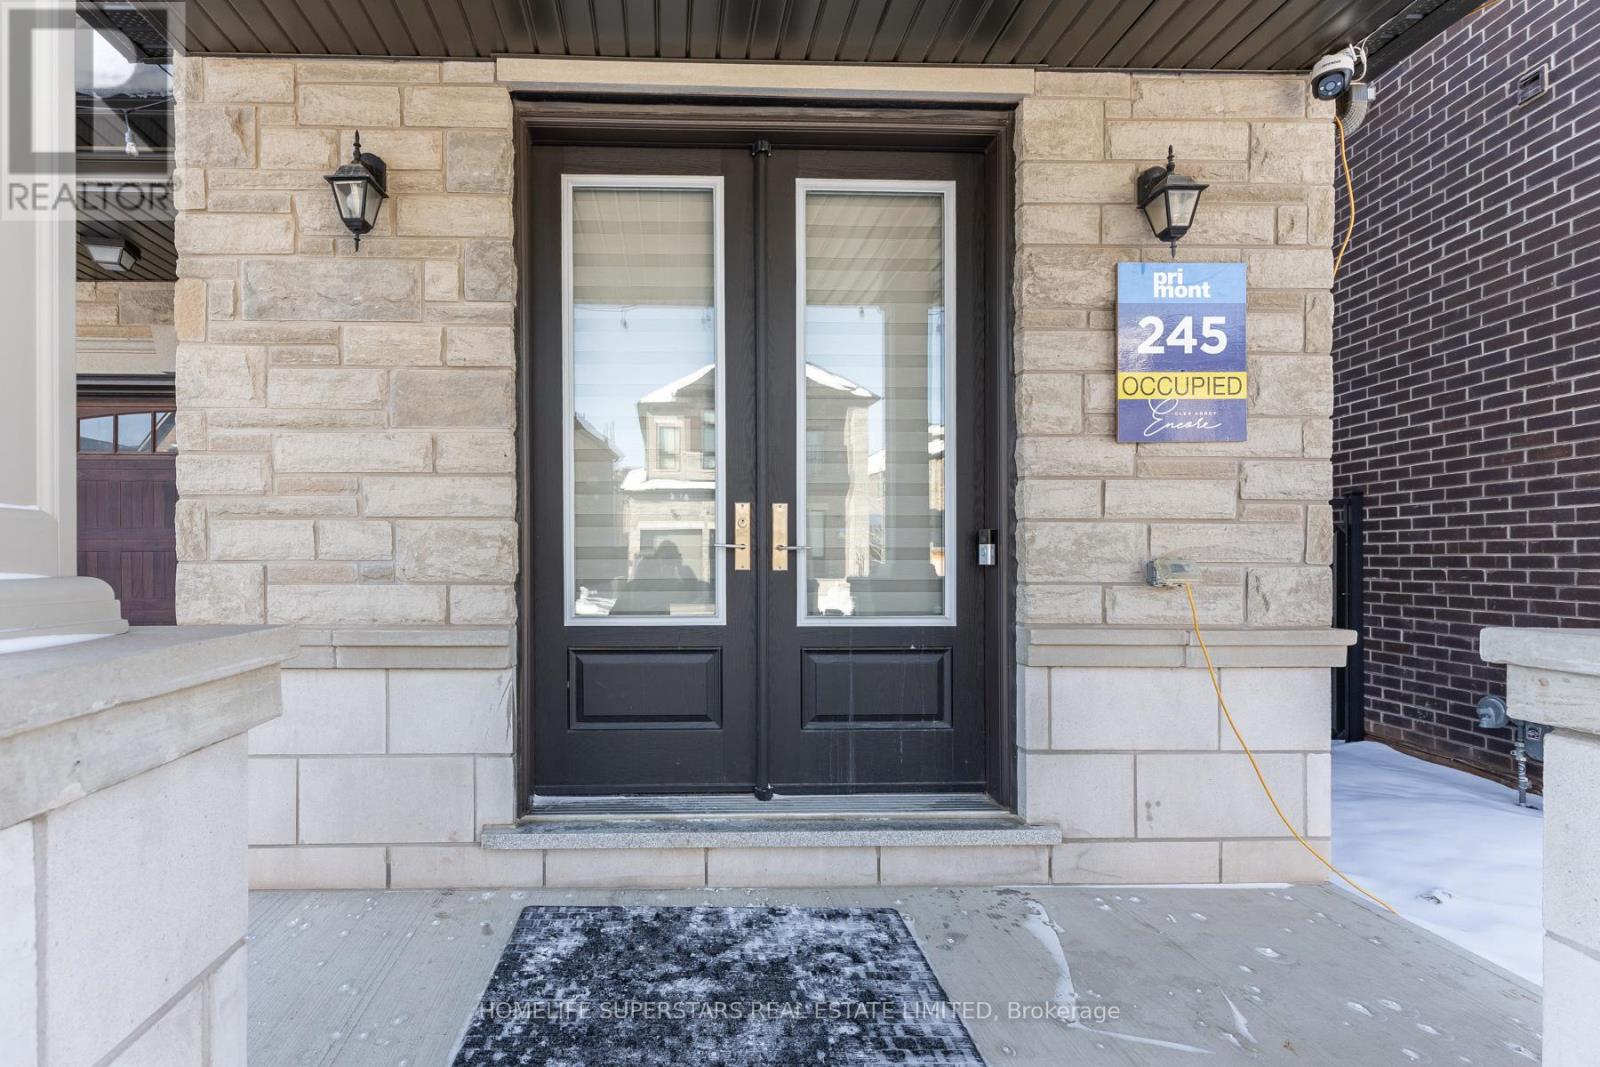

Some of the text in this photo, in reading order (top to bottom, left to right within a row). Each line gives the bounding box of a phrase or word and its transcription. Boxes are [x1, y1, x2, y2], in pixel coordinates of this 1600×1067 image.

[1154, 268, 1183, 286] pri
[1154, 284, 1211, 298] mont
[1137, 316, 1228, 354] 245
[1122, 376, 1242, 396] OCCUPIED
[1144, 399, 1222, 437] Encore
